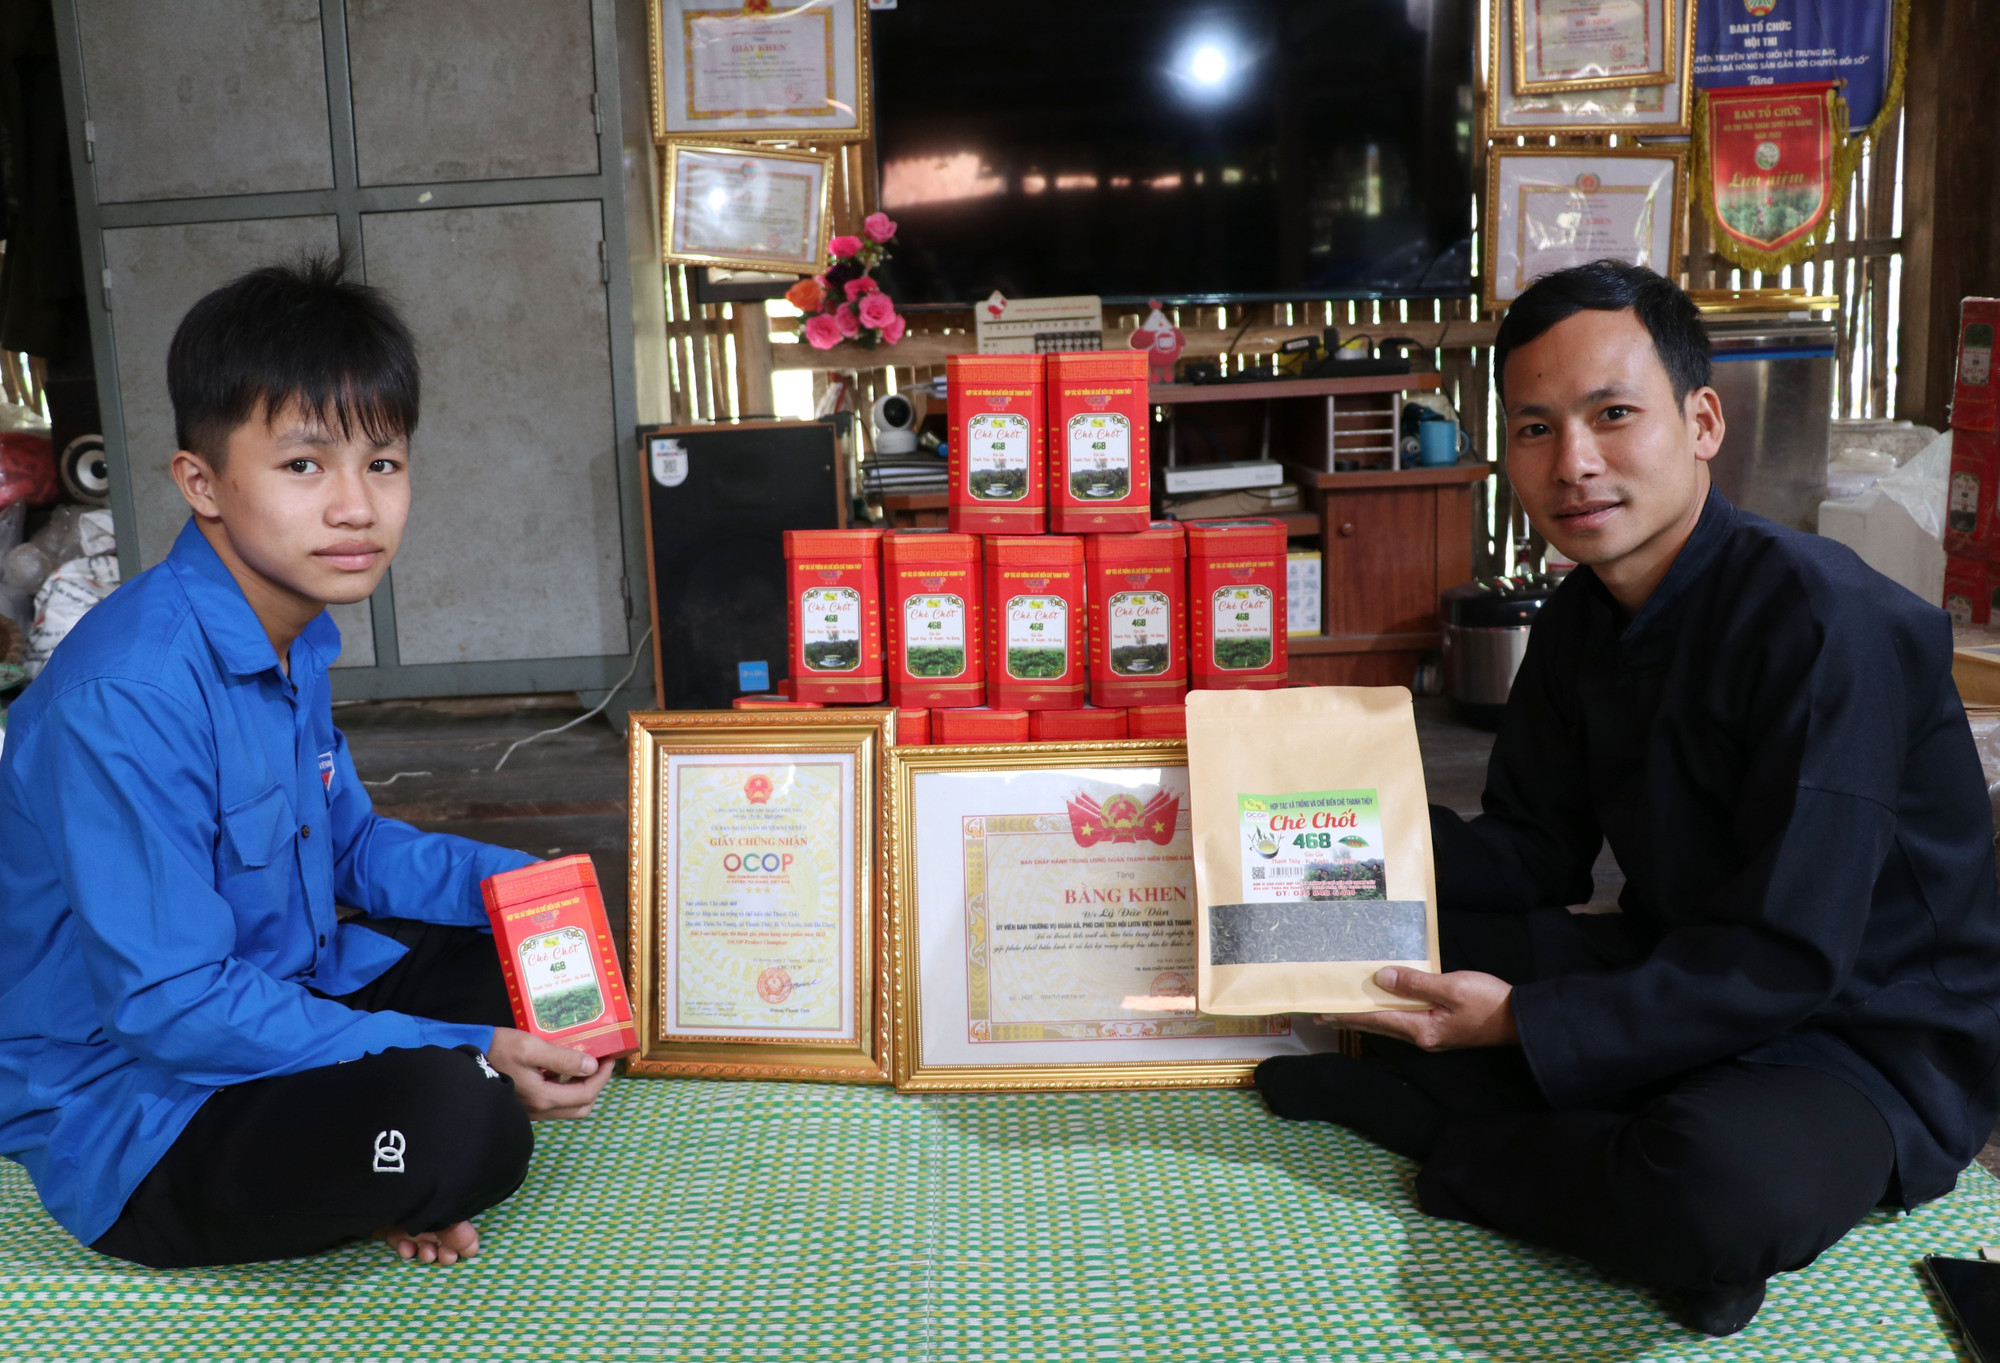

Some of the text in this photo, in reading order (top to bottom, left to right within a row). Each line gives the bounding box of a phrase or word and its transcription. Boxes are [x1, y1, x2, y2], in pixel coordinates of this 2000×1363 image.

[1730, 20, 1792, 34] BAN TỔ CHỨC
[1744, 37, 1777, 48] HỘI THI
[1747, 51, 1764, 60] VIÊN
[1795, 49, 1820, 57] TRƯNG
[1736, 62, 1758, 71] NÔNG
[1734, 104, 1801, 120] BAN TỔ CHỨC
[992, 442, 1005, 450] 468
[1092, 442, 1106, 450] 468
[825, 614, 838, 622] 468
[928, 621, 942, 629] 468
[1270, 808, 1358, 831] Chè Chốt
[711, 834, 808, 847] GIẤY CHỨNG NHẬN
[1292, 832, 1331, 849] 468
[723, 853, 794, 872] OCOP
[1116, 871, 1134, 880] Tặng
[1065, 882, 1187, 904] BẰNG KHEN
[528, 953, 549, 966] Chè
[550, 961, 566, 972] 468
